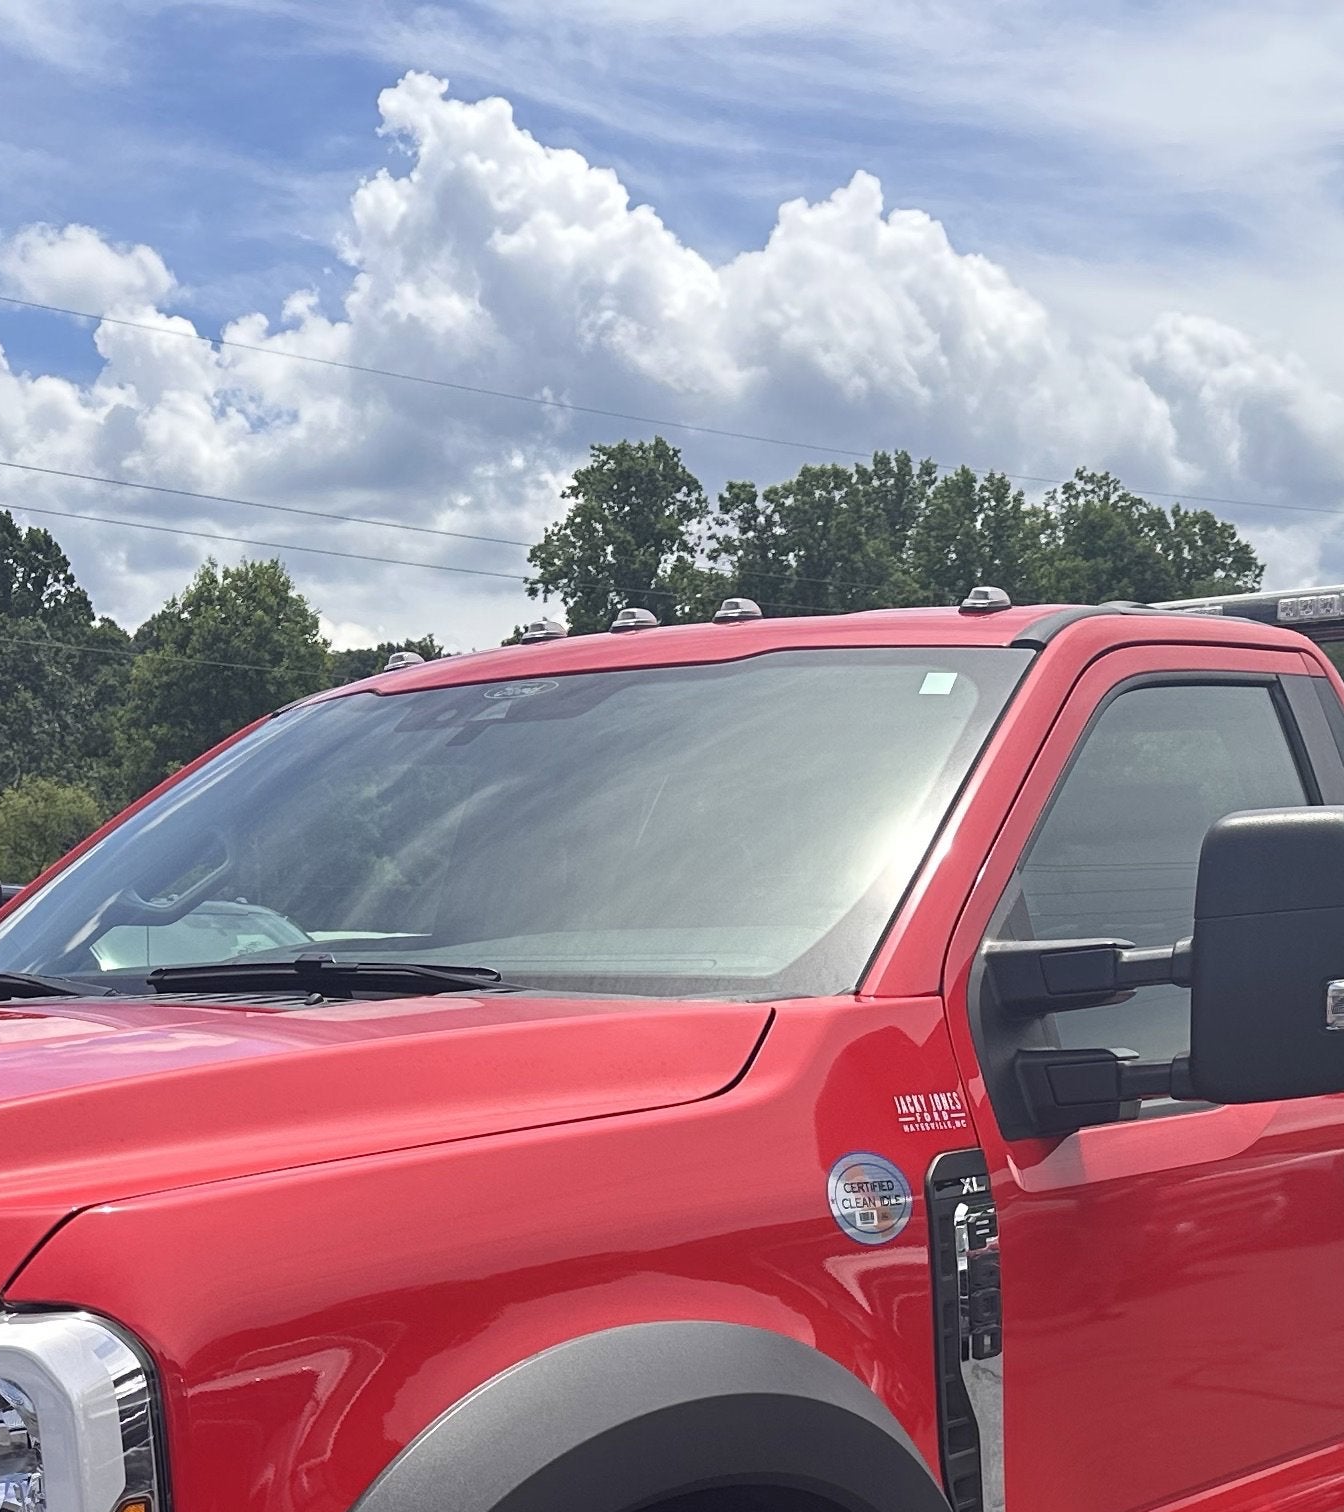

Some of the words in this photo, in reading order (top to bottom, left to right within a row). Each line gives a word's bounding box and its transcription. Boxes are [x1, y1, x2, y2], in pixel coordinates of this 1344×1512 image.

[894, 1094, 927, 1114] JACKY
[928, 1091, 961, 1112] JONES
[916, 1111, 948, 1122] FORD
[843, 1180, 895, 1193] CERTIFIED
[959, 1176, 986, 1195] XL
[841, 1196, 876, 1209] CLEAN
[879, 1194, 903, 1208] IDLE
